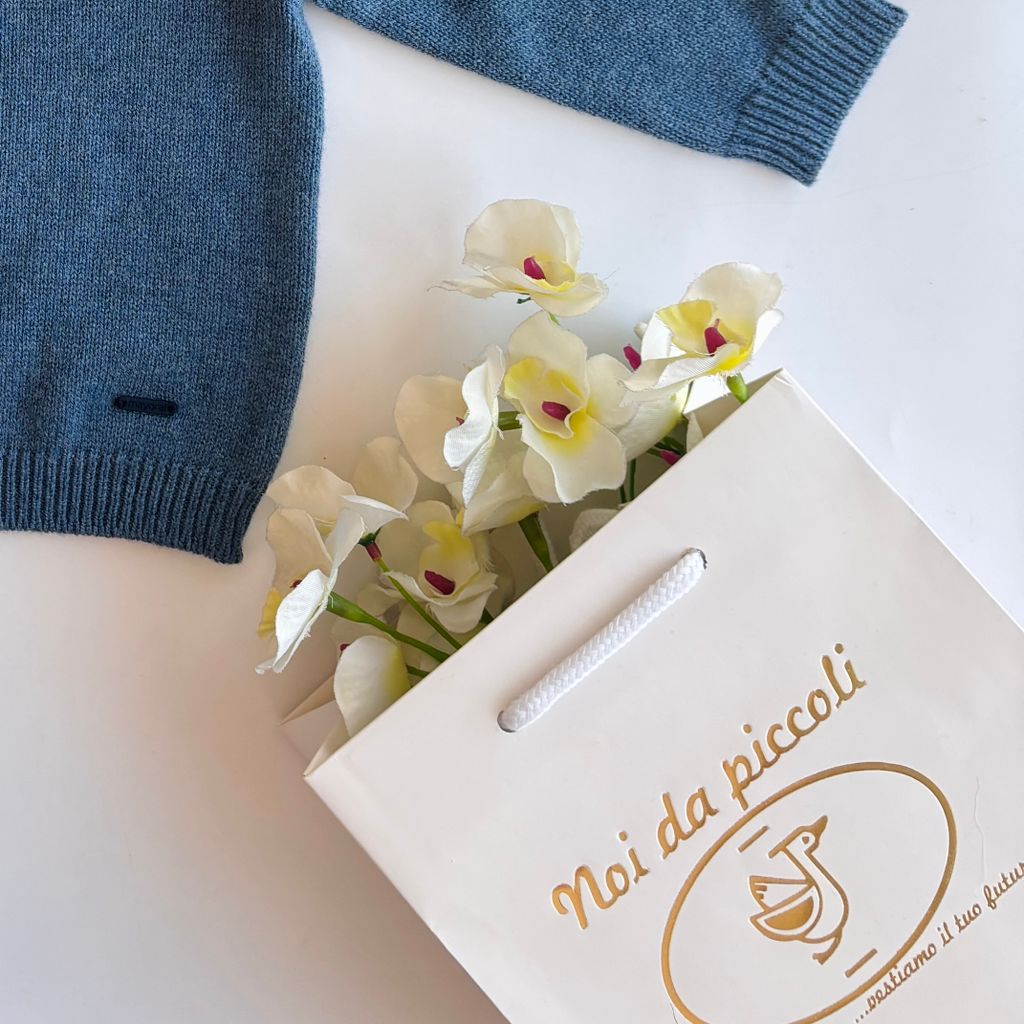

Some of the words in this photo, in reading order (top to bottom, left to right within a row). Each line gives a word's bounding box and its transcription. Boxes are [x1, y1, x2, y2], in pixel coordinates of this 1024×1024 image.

[551, 831, 650, 930] Noi
[656, 787, 719, 860] da
[722, 642, 867, 810] piccoli
[937, 922, 954, 947] il
[953, 903, 982, 933] tuo
